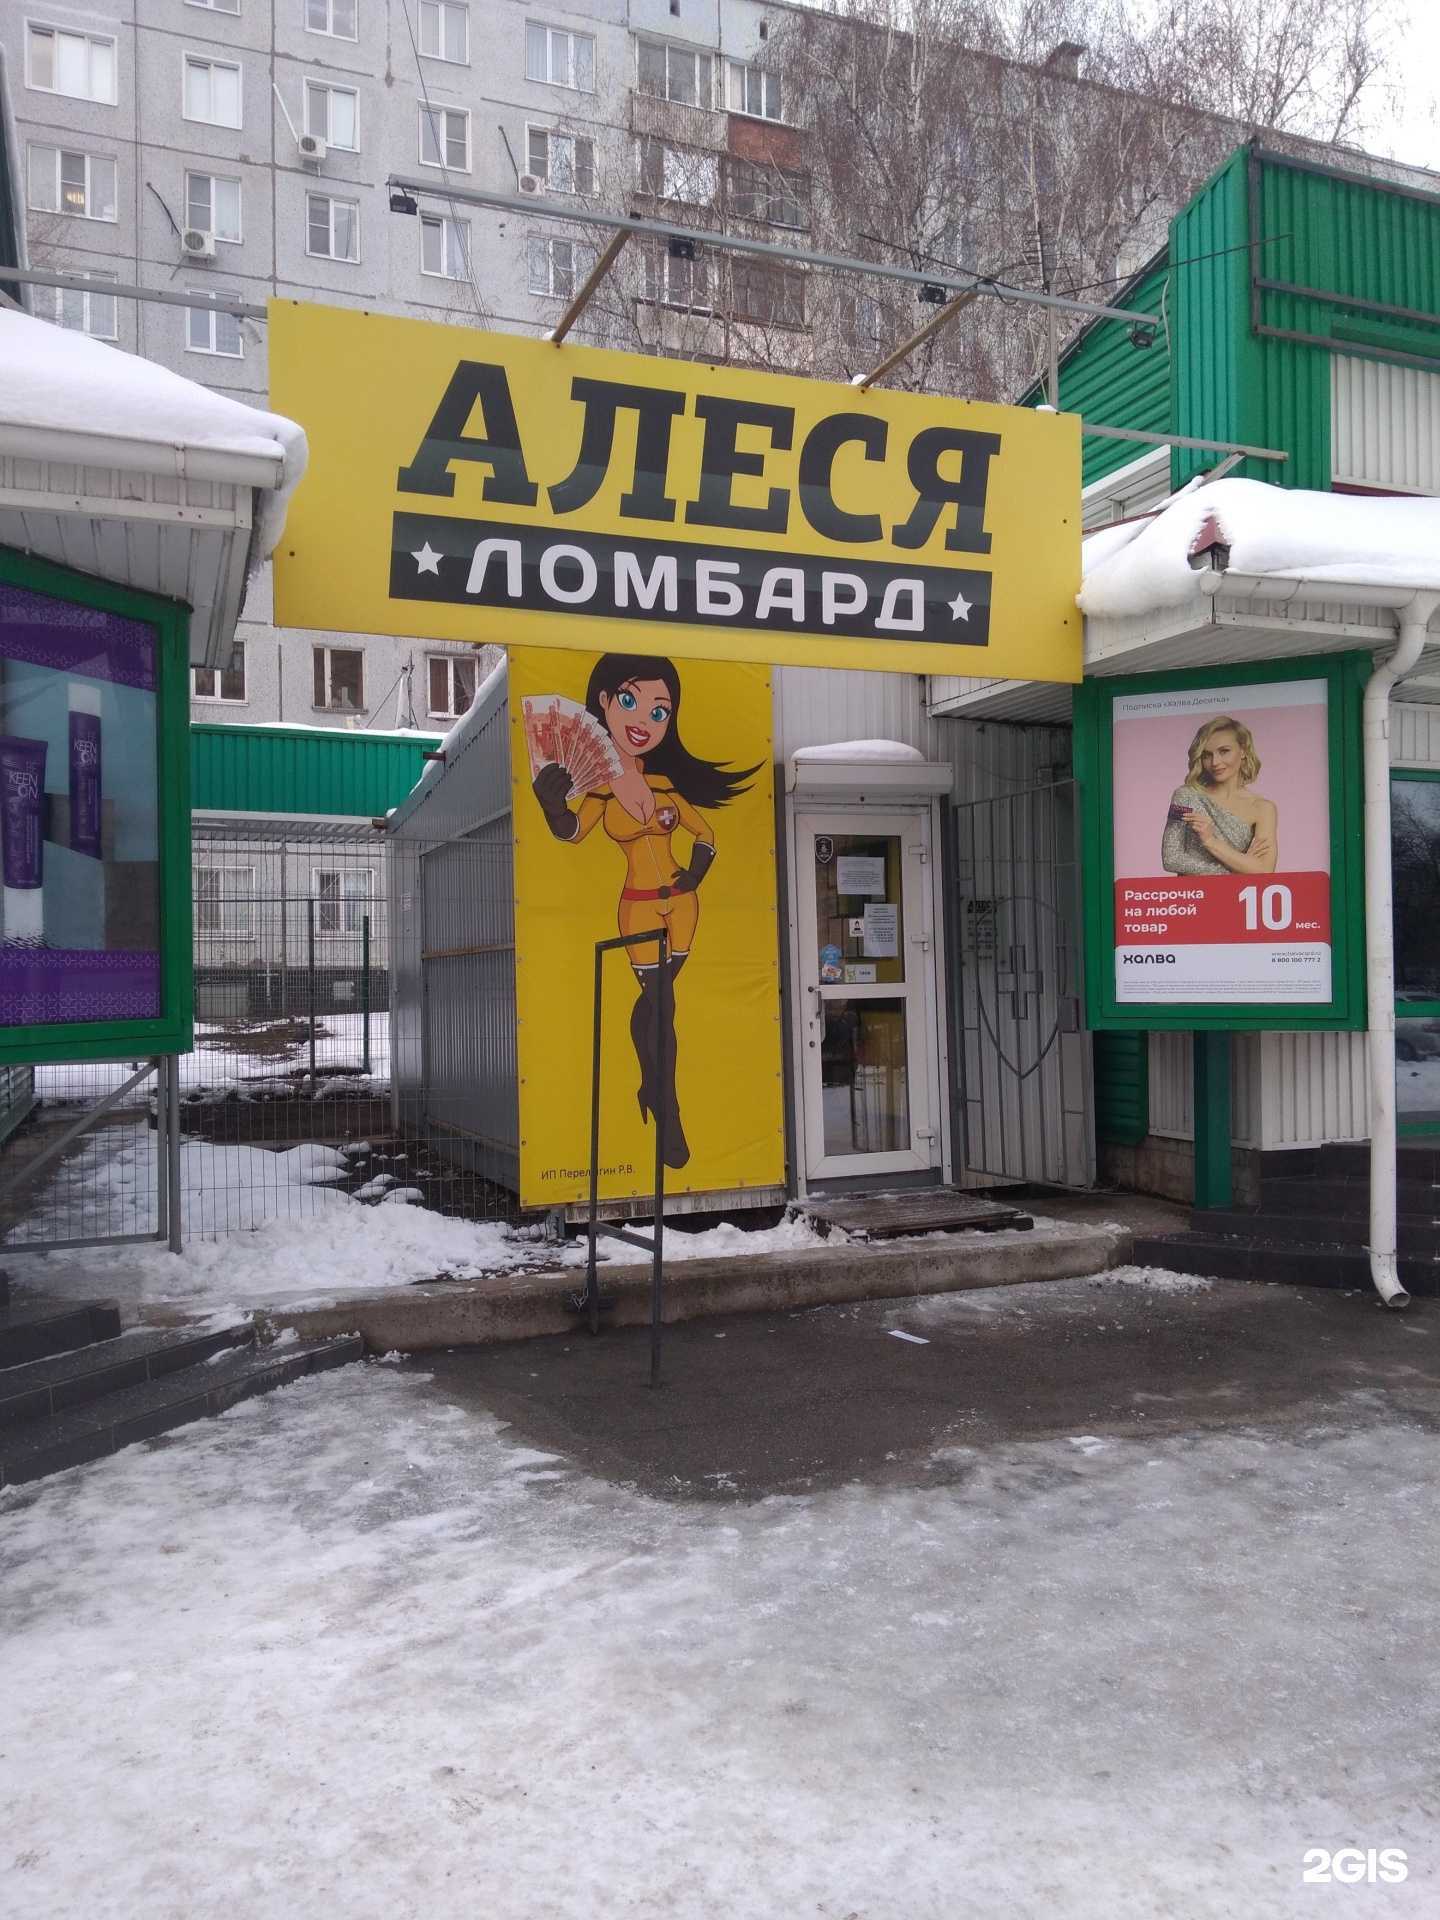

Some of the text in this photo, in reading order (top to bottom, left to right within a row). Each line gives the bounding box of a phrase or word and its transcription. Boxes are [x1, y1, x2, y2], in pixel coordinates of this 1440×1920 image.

[396, 359, 1001, 555] АЛЕСЯ
[465, 538, 926, 632] ЛОМБАРД
[73, 739, 97, 754] KEEN
[8, 771, 38, 786] KEEN
[1124, 889, 1205, 903] Рассрочка
[1124, 903, 1198, 917] на любой
[1238, 884, 1292, 931] 10
[1124, 922, 1168, 935] товар
[1295, 921, 1321, 930] мес.
[541, 1170, 557, 1180] ИП
[559, 1166, 616, 1180] Перелгин
